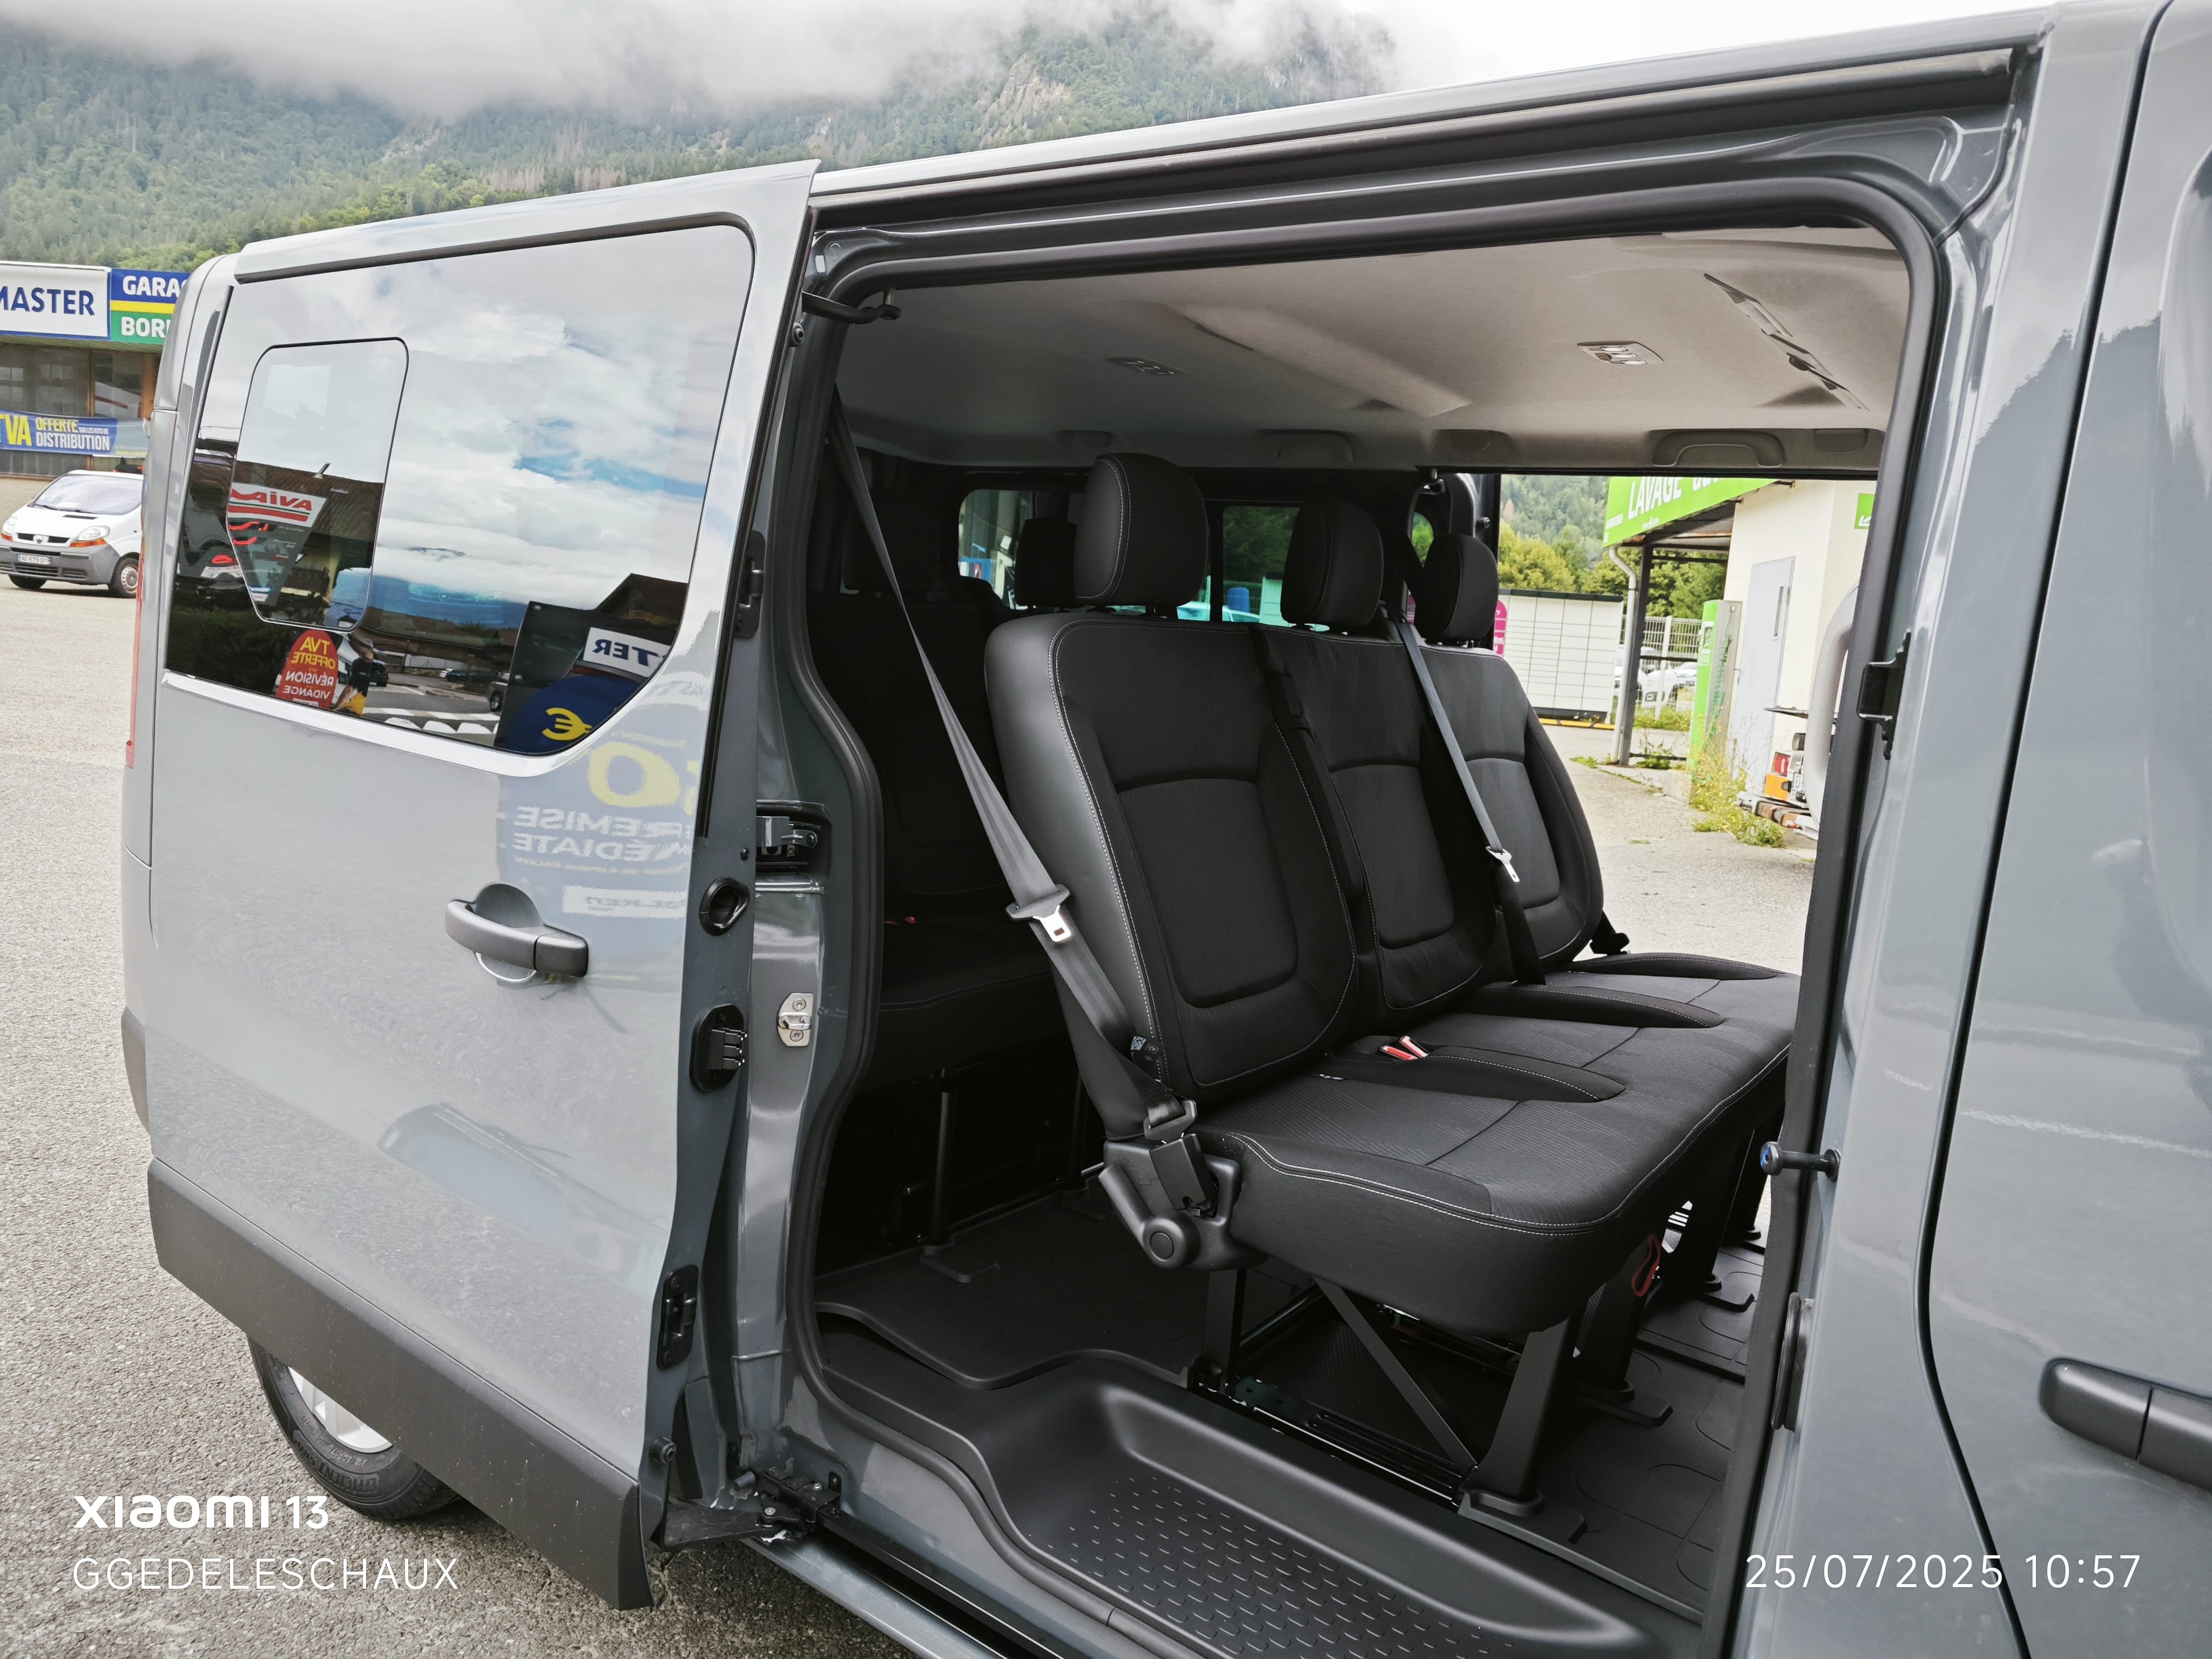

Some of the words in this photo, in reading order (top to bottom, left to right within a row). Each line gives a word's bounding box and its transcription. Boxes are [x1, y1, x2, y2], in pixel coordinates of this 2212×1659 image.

[123, 275, 187, 298] GARA
[0, 414, 32, 446] VA
[35, 417, 79, 433] OFFERTE
[36, 431, 110, 451] DISTRIBUTION
[1628, 477, 1683, 520] LAVAGE
